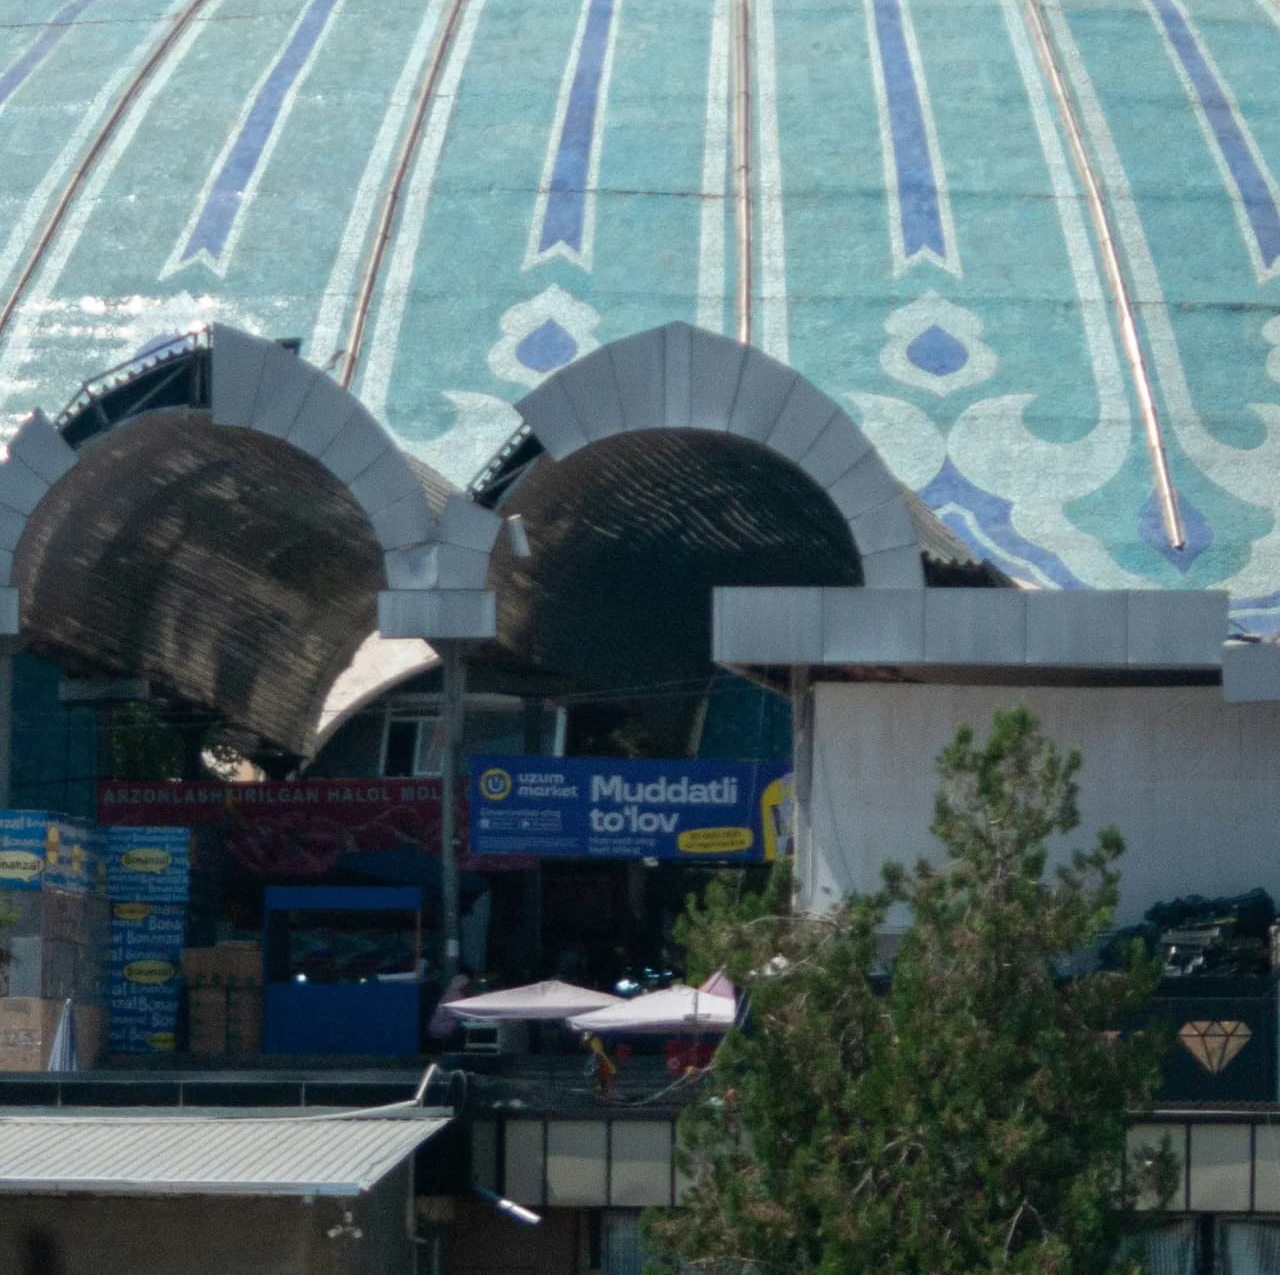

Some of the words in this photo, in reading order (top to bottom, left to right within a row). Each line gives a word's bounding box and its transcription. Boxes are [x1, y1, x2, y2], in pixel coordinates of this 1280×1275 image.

[518, 772, 564, 784] uzum
[517, 785, 578, 798] market
[591, 774, 738, 805] Muddatli
[589, 804, 680, 833] to'lov
